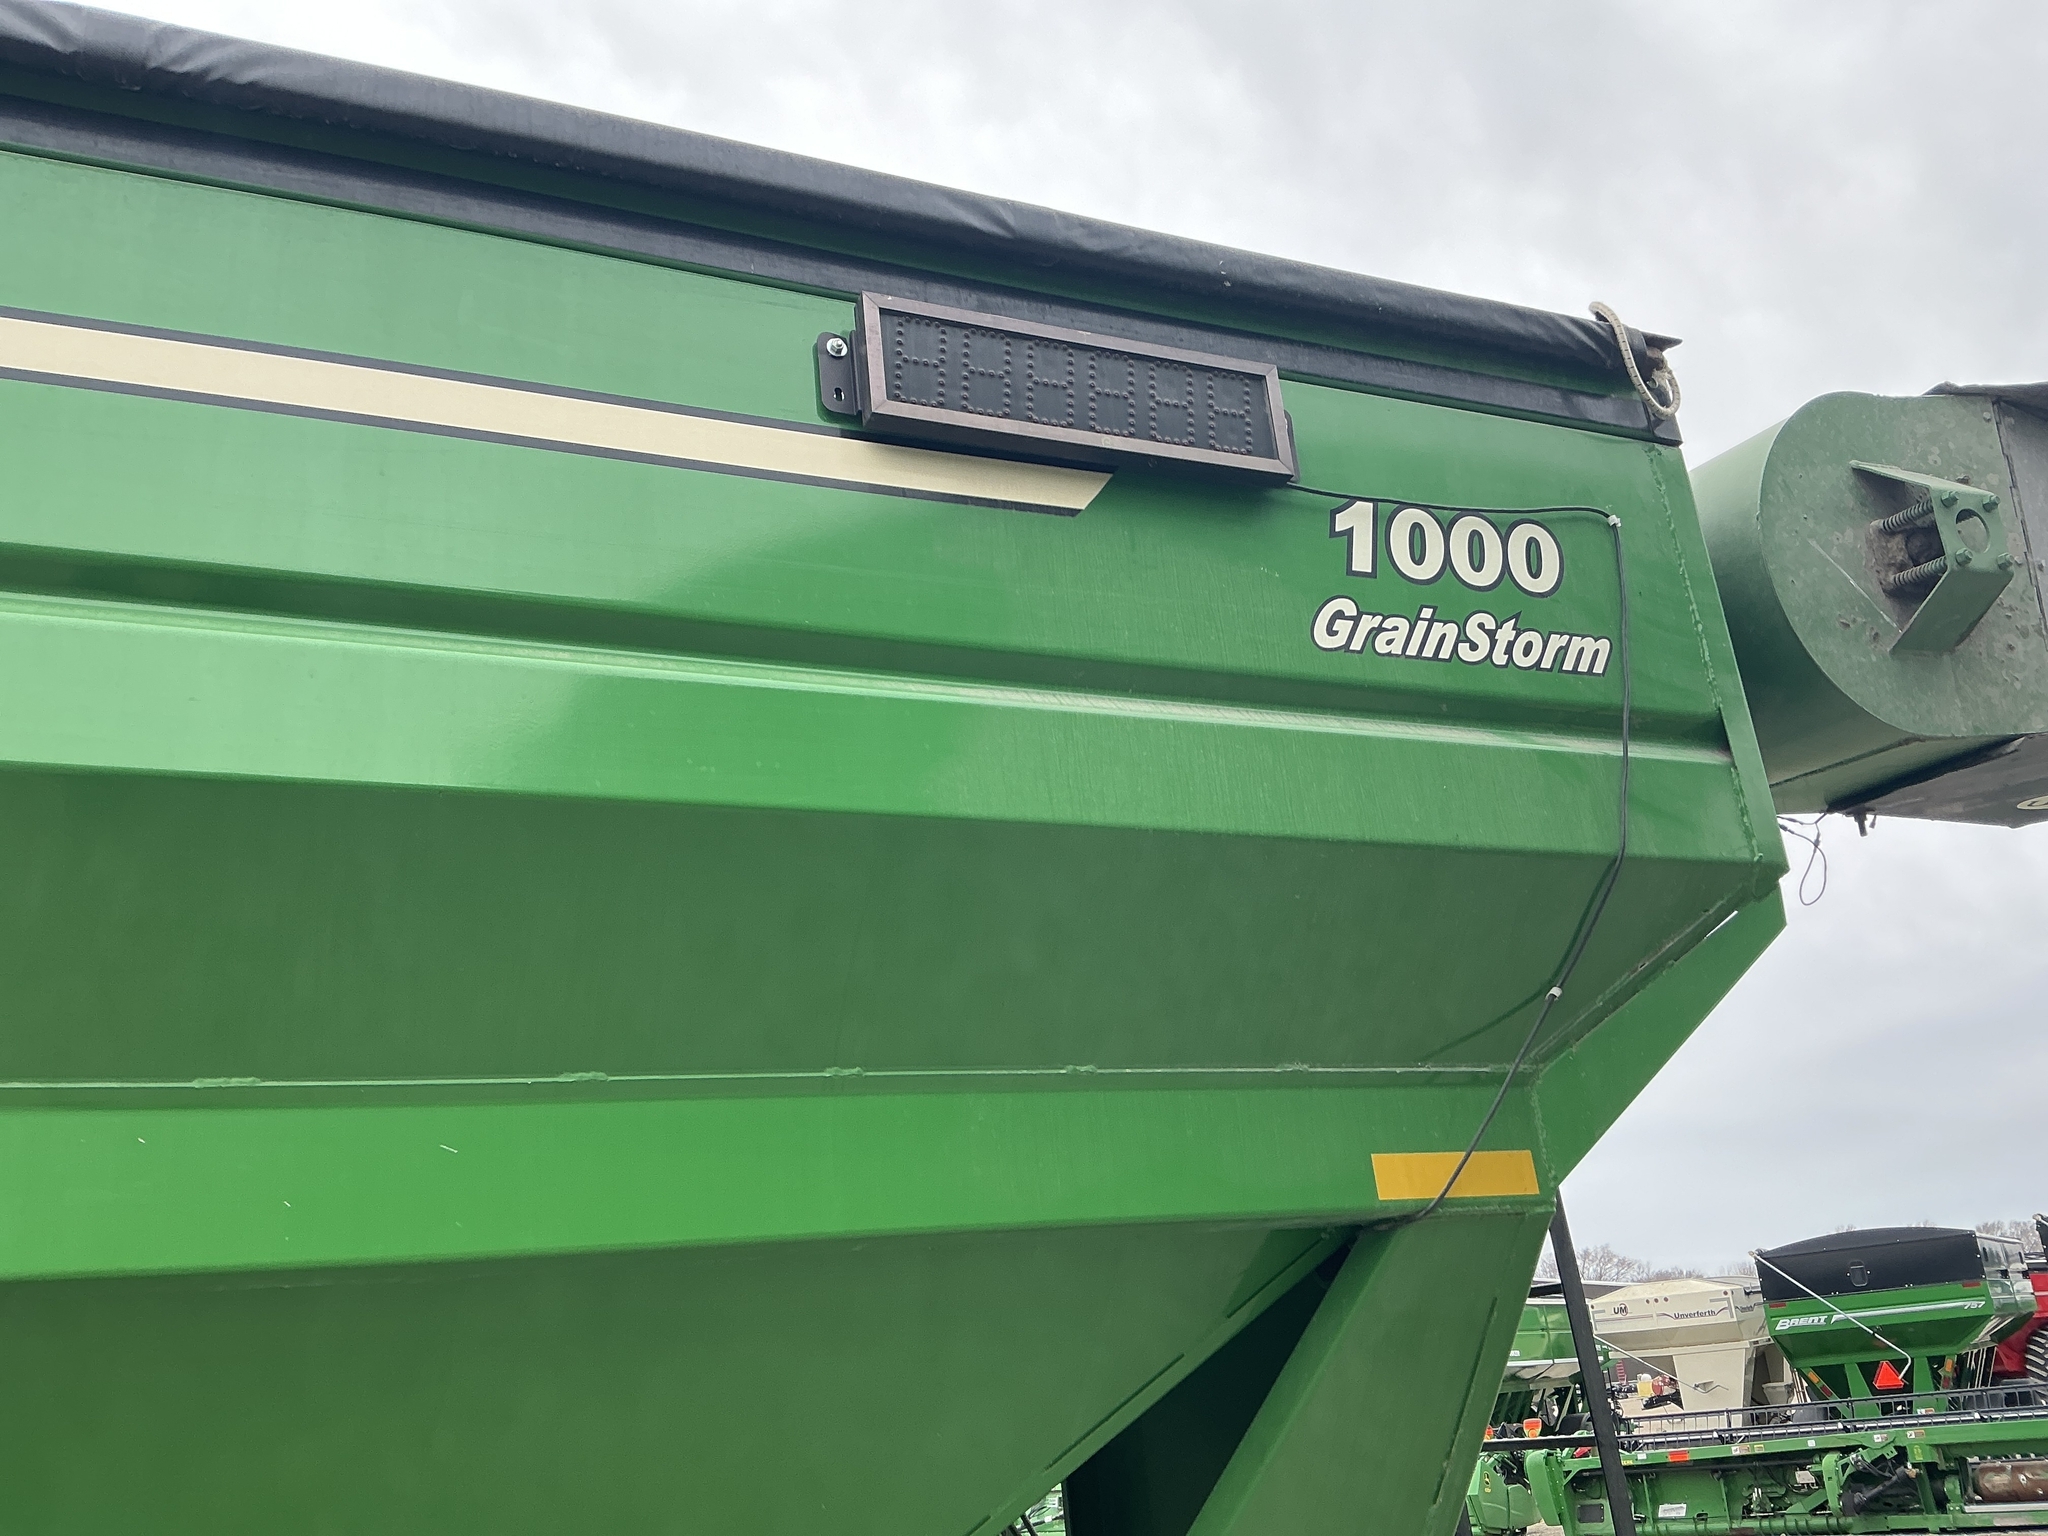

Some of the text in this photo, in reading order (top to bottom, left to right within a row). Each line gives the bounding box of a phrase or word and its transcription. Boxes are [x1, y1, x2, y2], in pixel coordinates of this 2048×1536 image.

[1329, 499, 1564, 598] 1000
[1311, 595, 1612, 677] GrainStorm
[1673, 1309, 1716, 1319] Unverferth
[1963, 1301, 1986, 1310] 757
